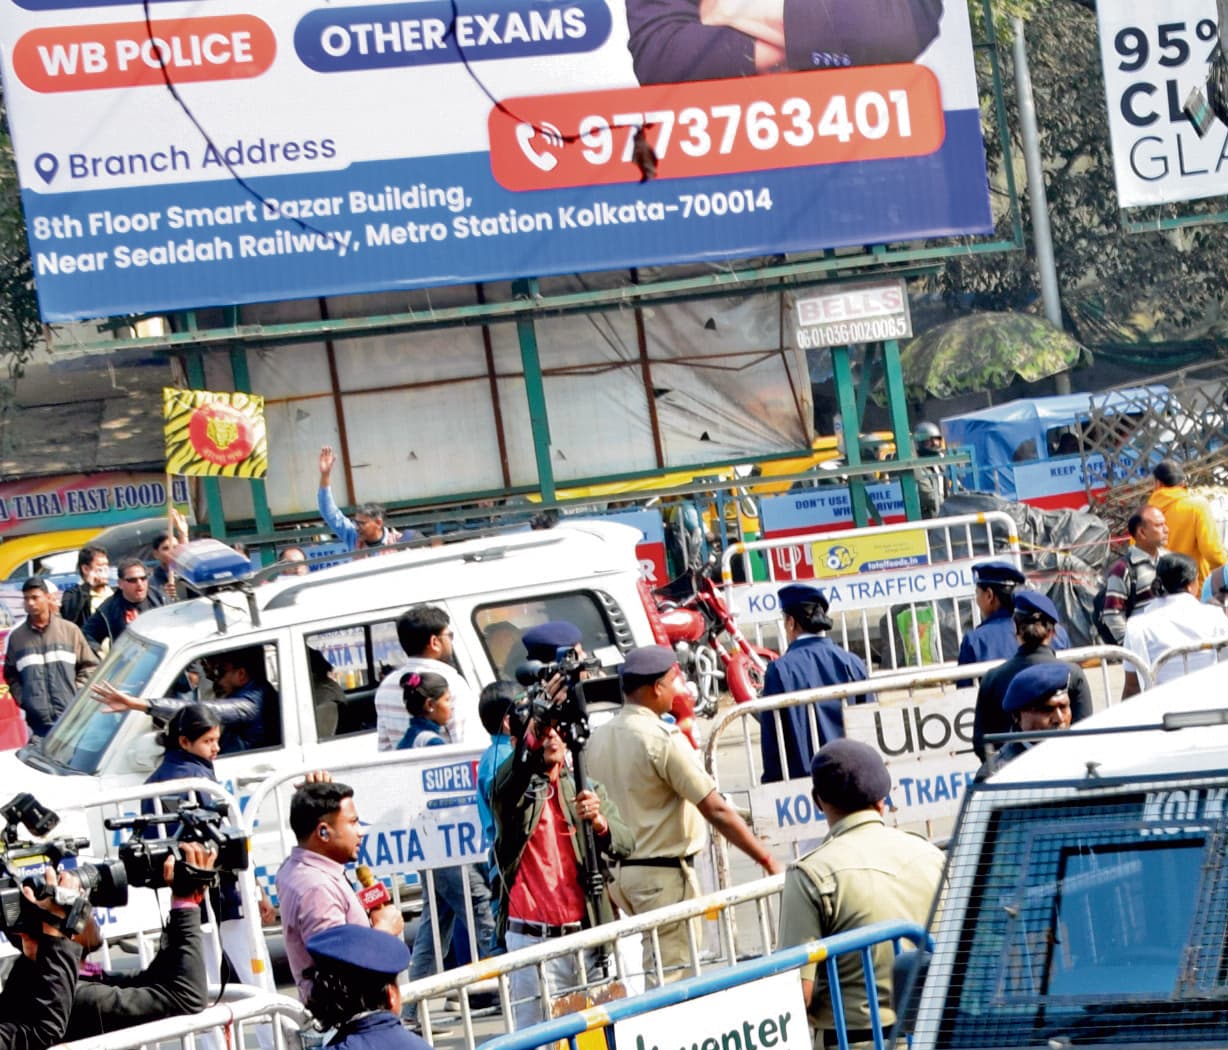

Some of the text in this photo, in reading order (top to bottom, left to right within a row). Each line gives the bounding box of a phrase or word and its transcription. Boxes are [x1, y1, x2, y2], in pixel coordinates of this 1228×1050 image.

[321, 7, 587, 57] OTHER EXAMS
[38, 31, 252, 77] WB POLICE
[579, 89, 912, 165] 9773763401
[69, 136, 336, 179] Branch Address
[33, 183, 473, 241] 8th Floor Smart Bazar Building,
[37, 187, 773, 277] Near Sealdah Railway, Metro Station Kolkata-700014
[800, 290, 901, 321] BELLS
[1050, 465, 1077, 478] KEEP
[13, 493, 63, 519] TARA
[66, 486, 109, 514] FAST
[113, 481, 166, 509] FOOD
[795, 497, 825, 510] DON'T
[828, 495, 849, 506] USE
[850, 571, 932, 601] TRAFFIC
[874, 706, 975, 756] Ube
[425, 764, 472, 790] SUPER
[358, 828, 425, 867] KATA
